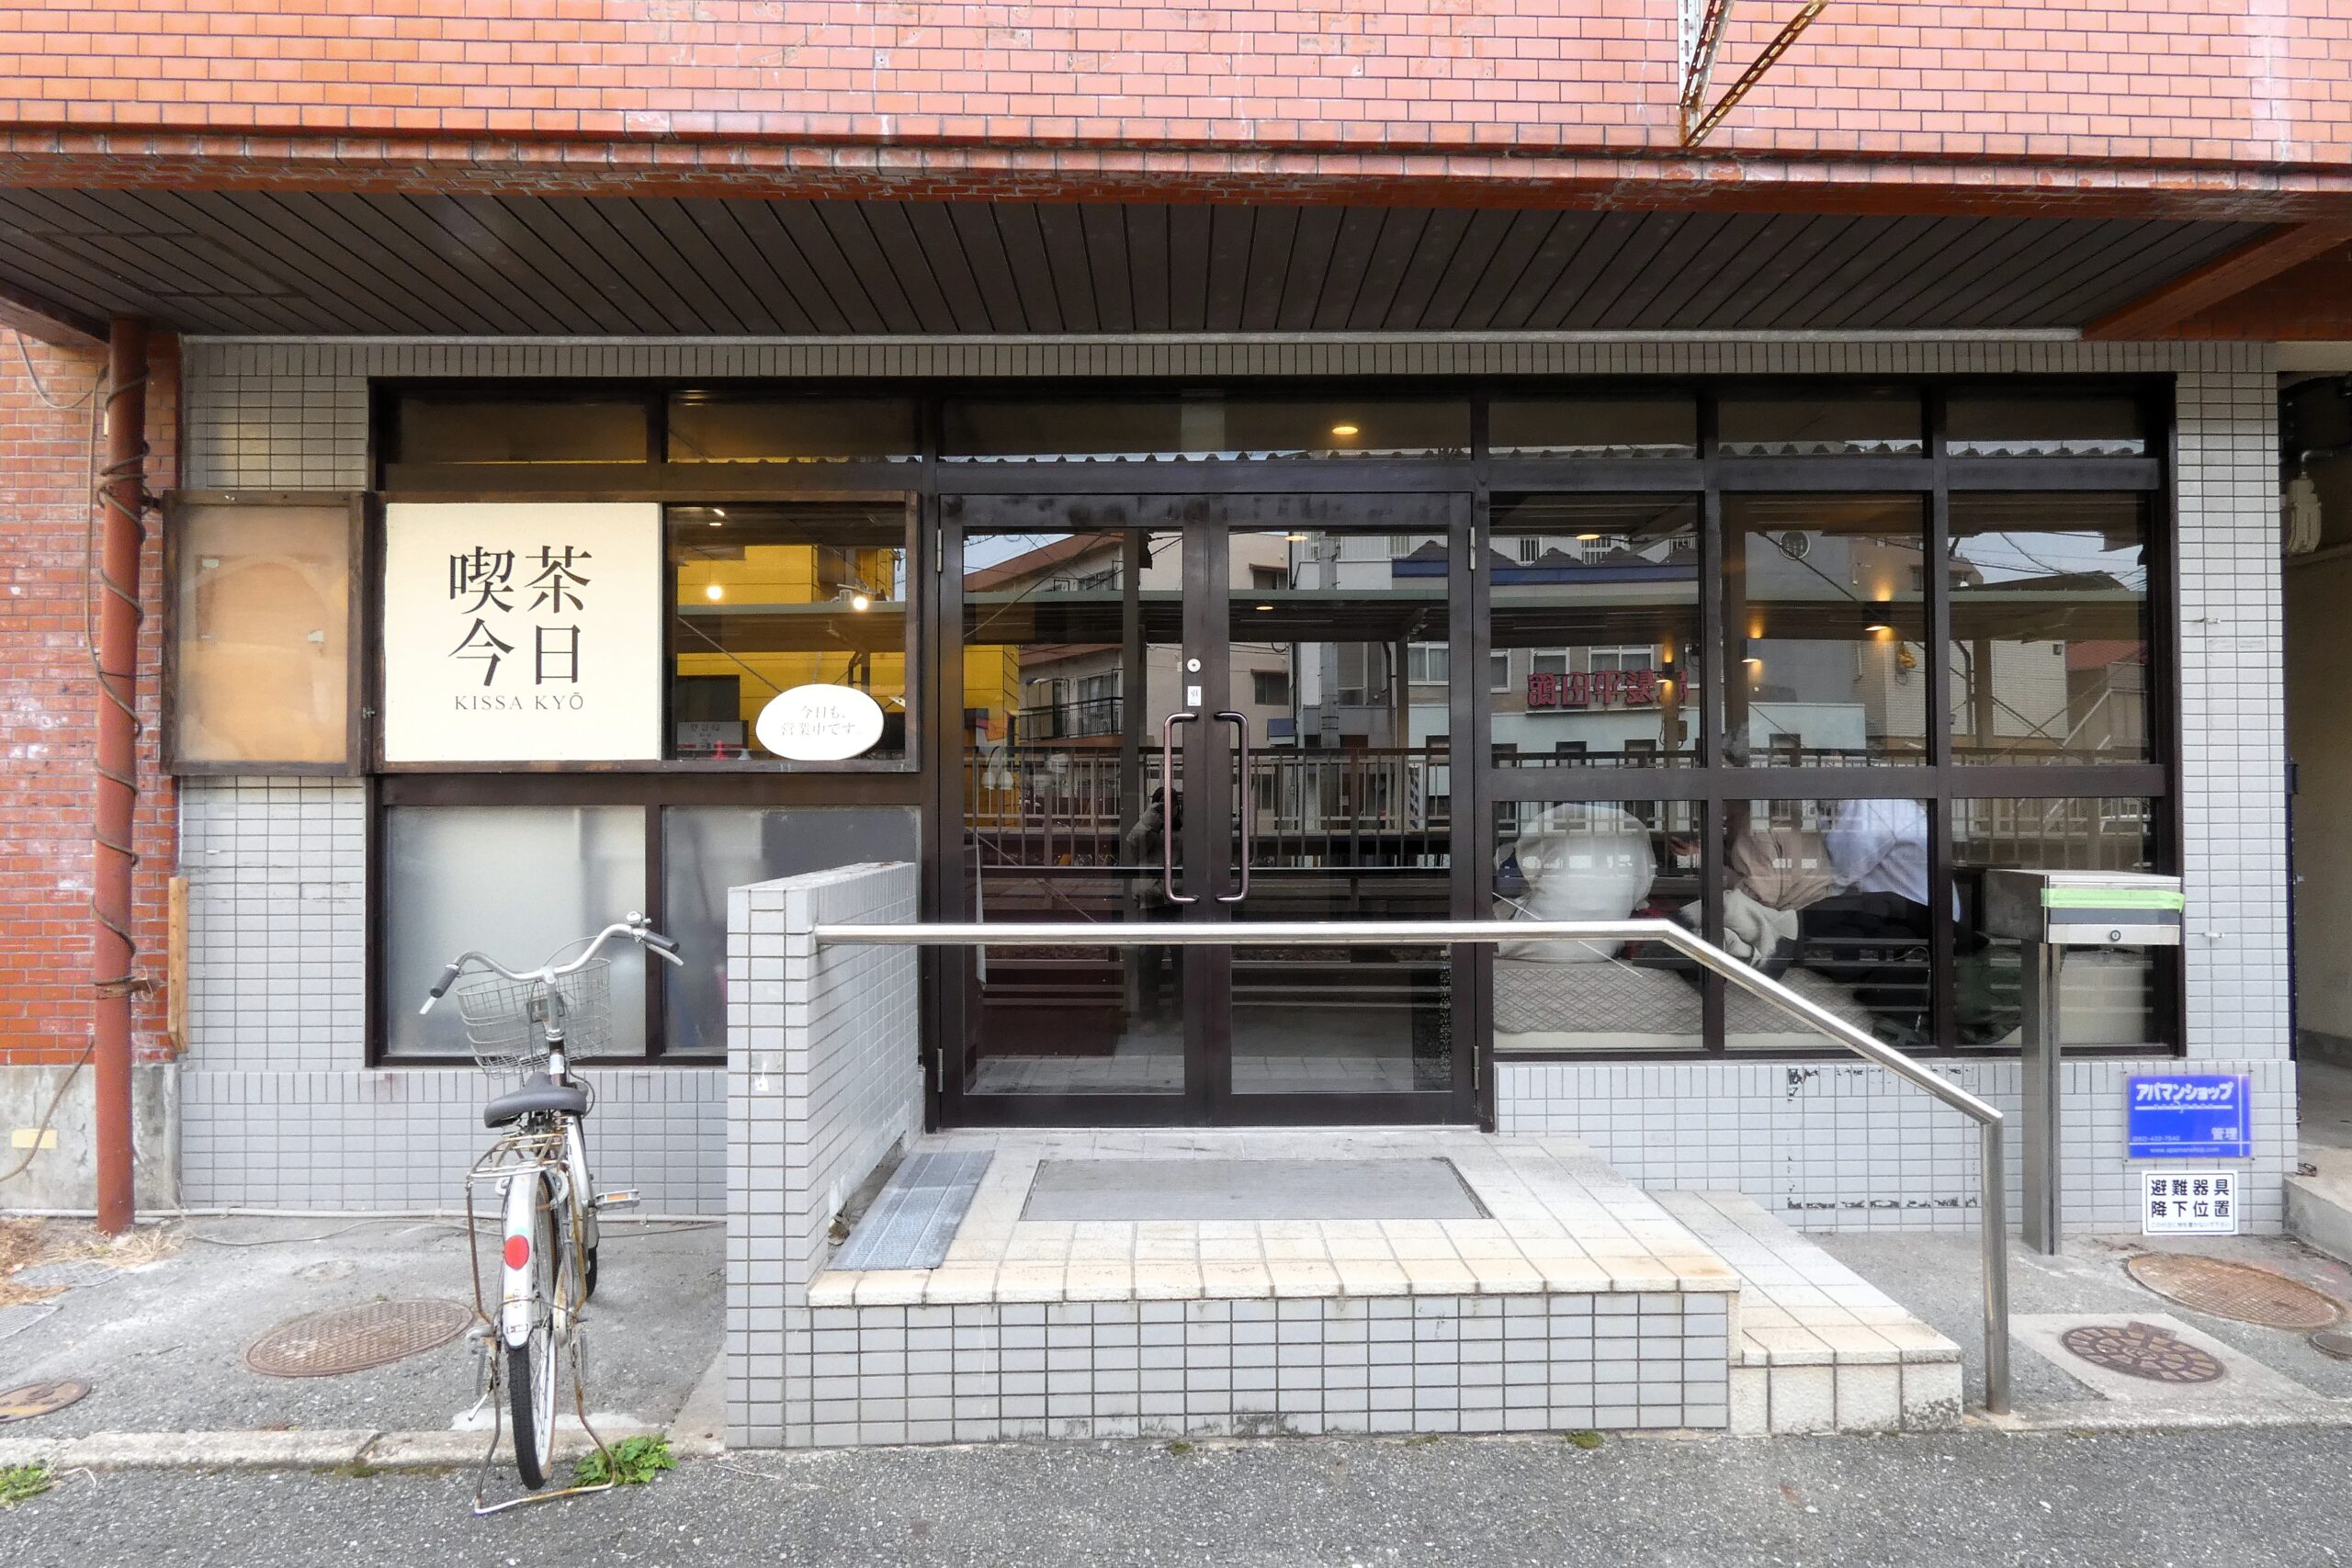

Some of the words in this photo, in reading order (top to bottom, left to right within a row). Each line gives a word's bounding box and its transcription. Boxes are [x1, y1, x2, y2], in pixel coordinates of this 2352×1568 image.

[449, 545, 593, 615] 喫茶
[448, 617, 582, 687] 今日
[455, 695, 523, 710] KISSA
[535, 692, 583, 710] KYŌ
[2135, 1081, 2234, 1101] アパマンショップ
[2211, 1127, 2239, 1141] 管理
[2151, 1179, 2230, 1196] 避難器具
[2151, 1200, 2230, 1218] 降下位置
